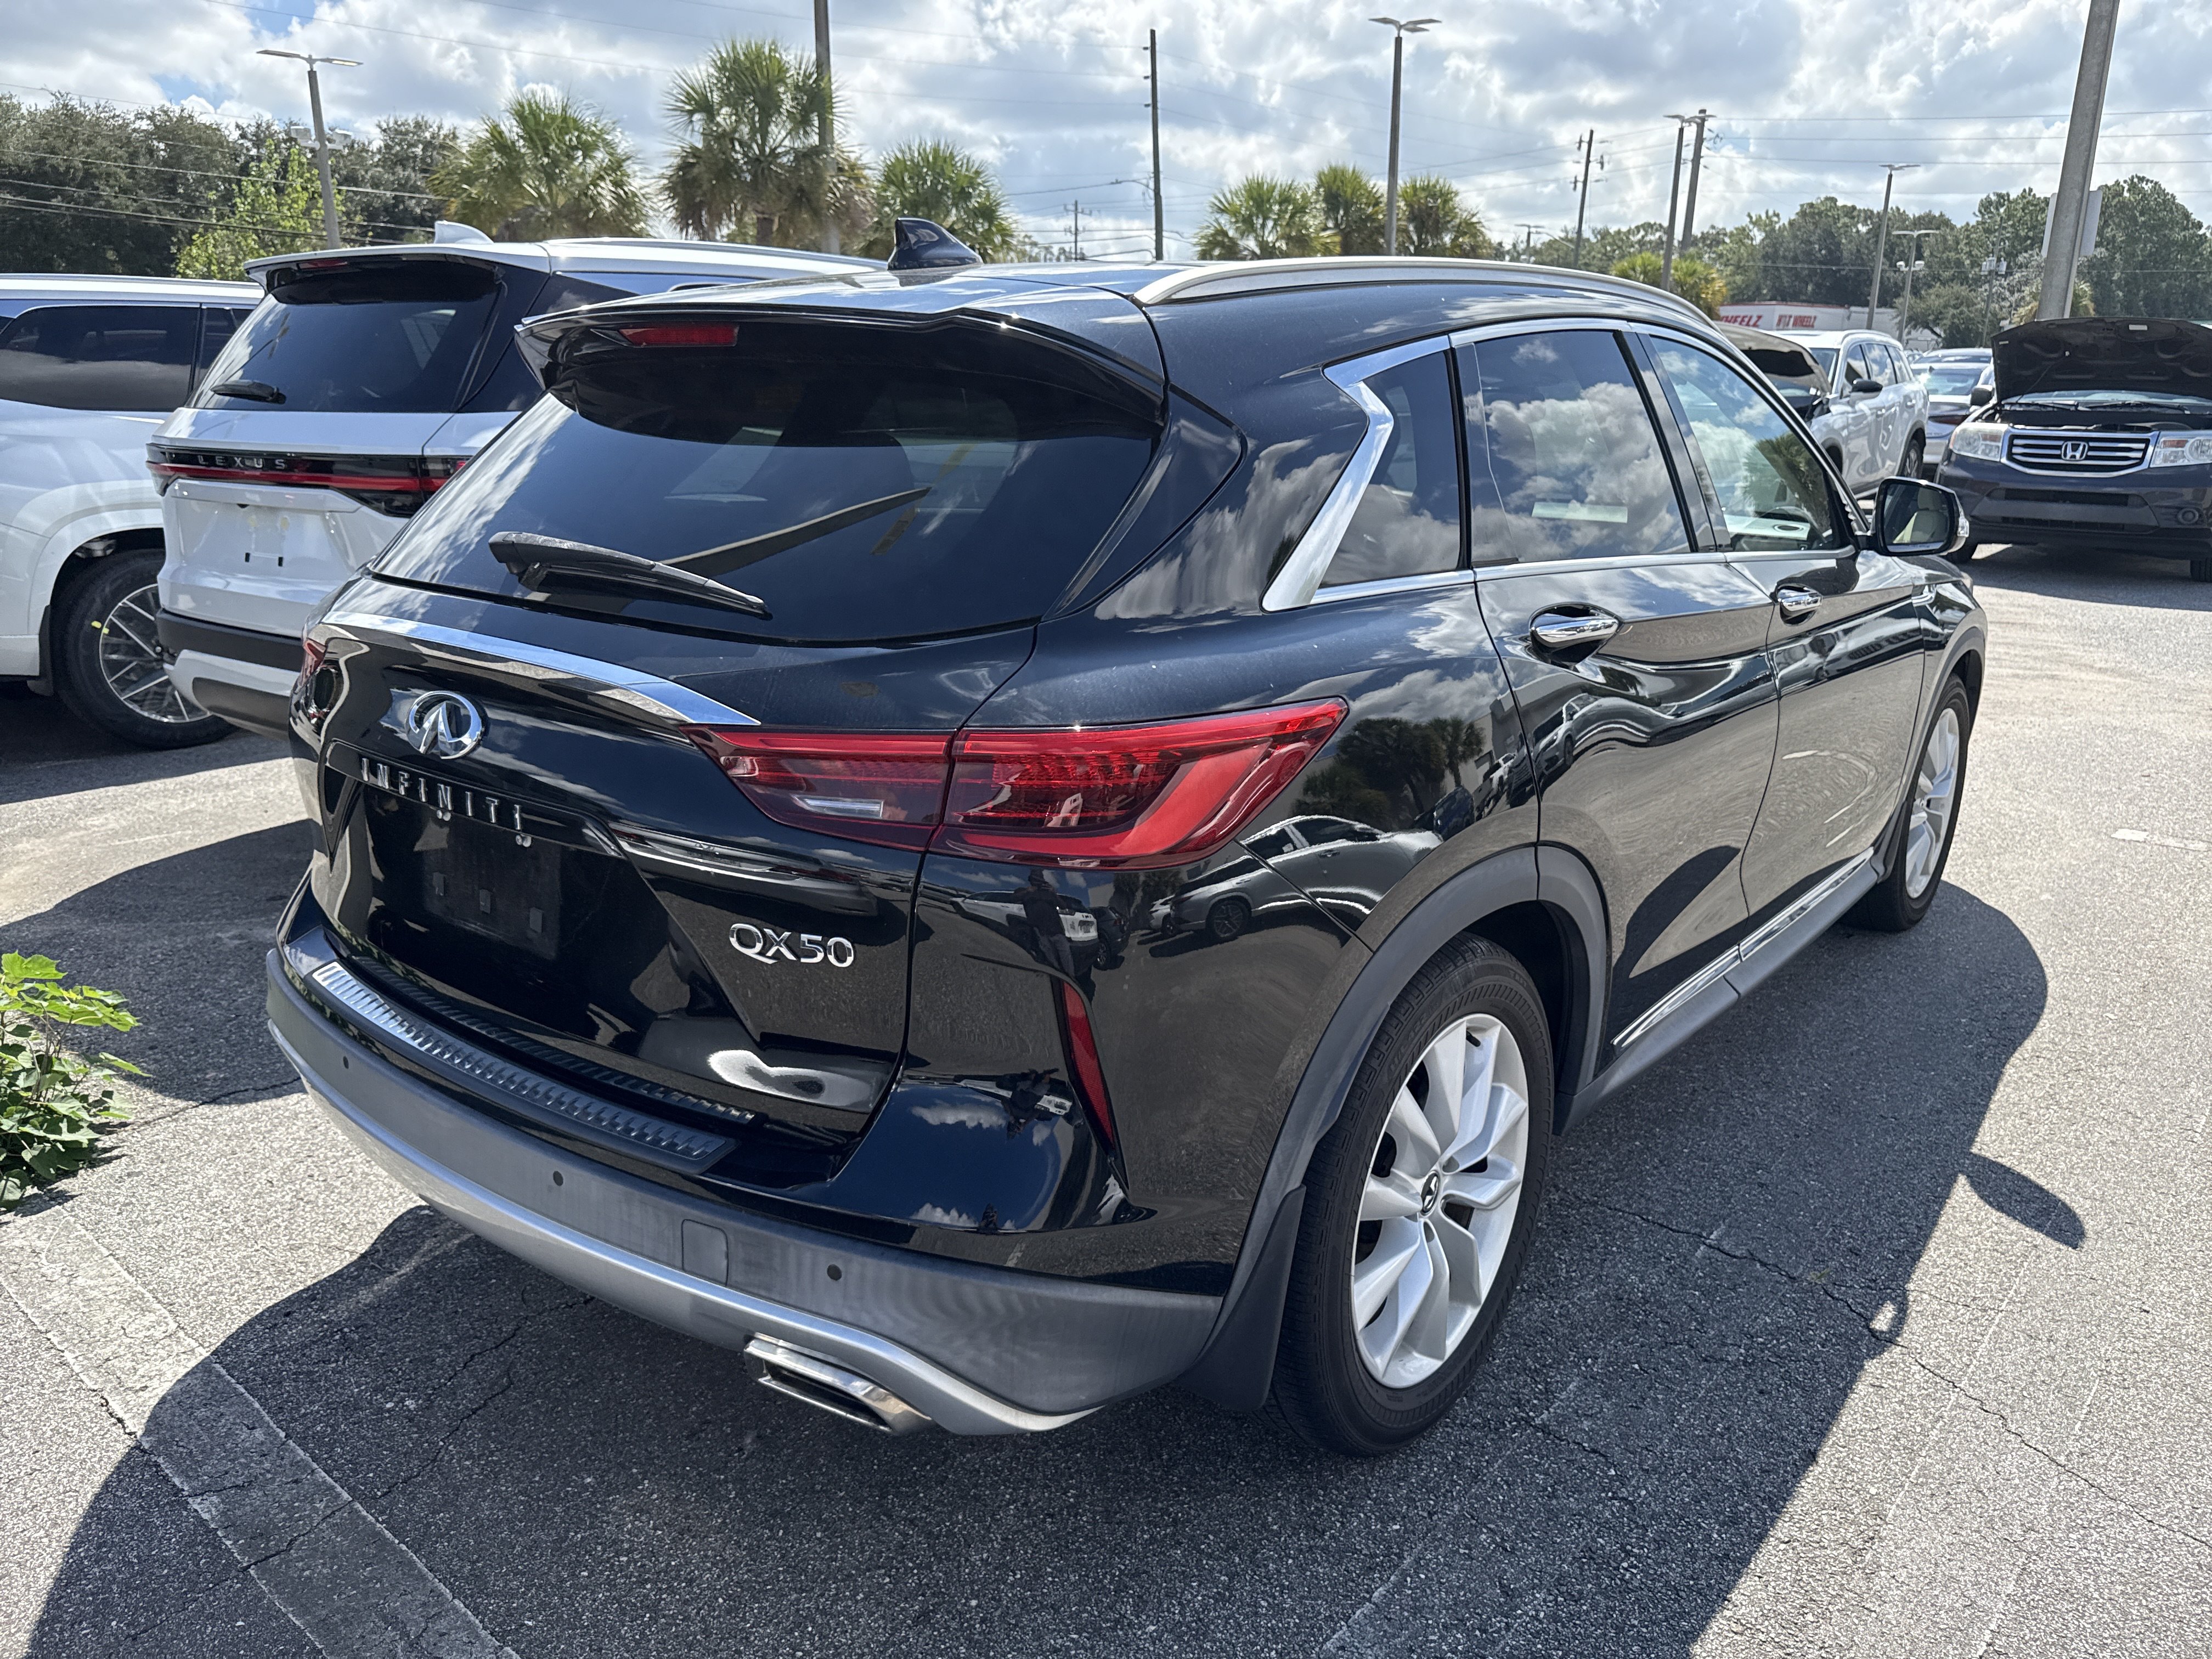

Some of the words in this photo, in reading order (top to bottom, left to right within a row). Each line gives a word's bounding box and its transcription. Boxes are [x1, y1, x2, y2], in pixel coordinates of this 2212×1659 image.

[1792, 315, 1816, 328] WHEELZ
[198, 455, 286, 470] LEXUS
[362, 758, 522, 830] INFINITI
[729, 923, 854, 967] QX50
